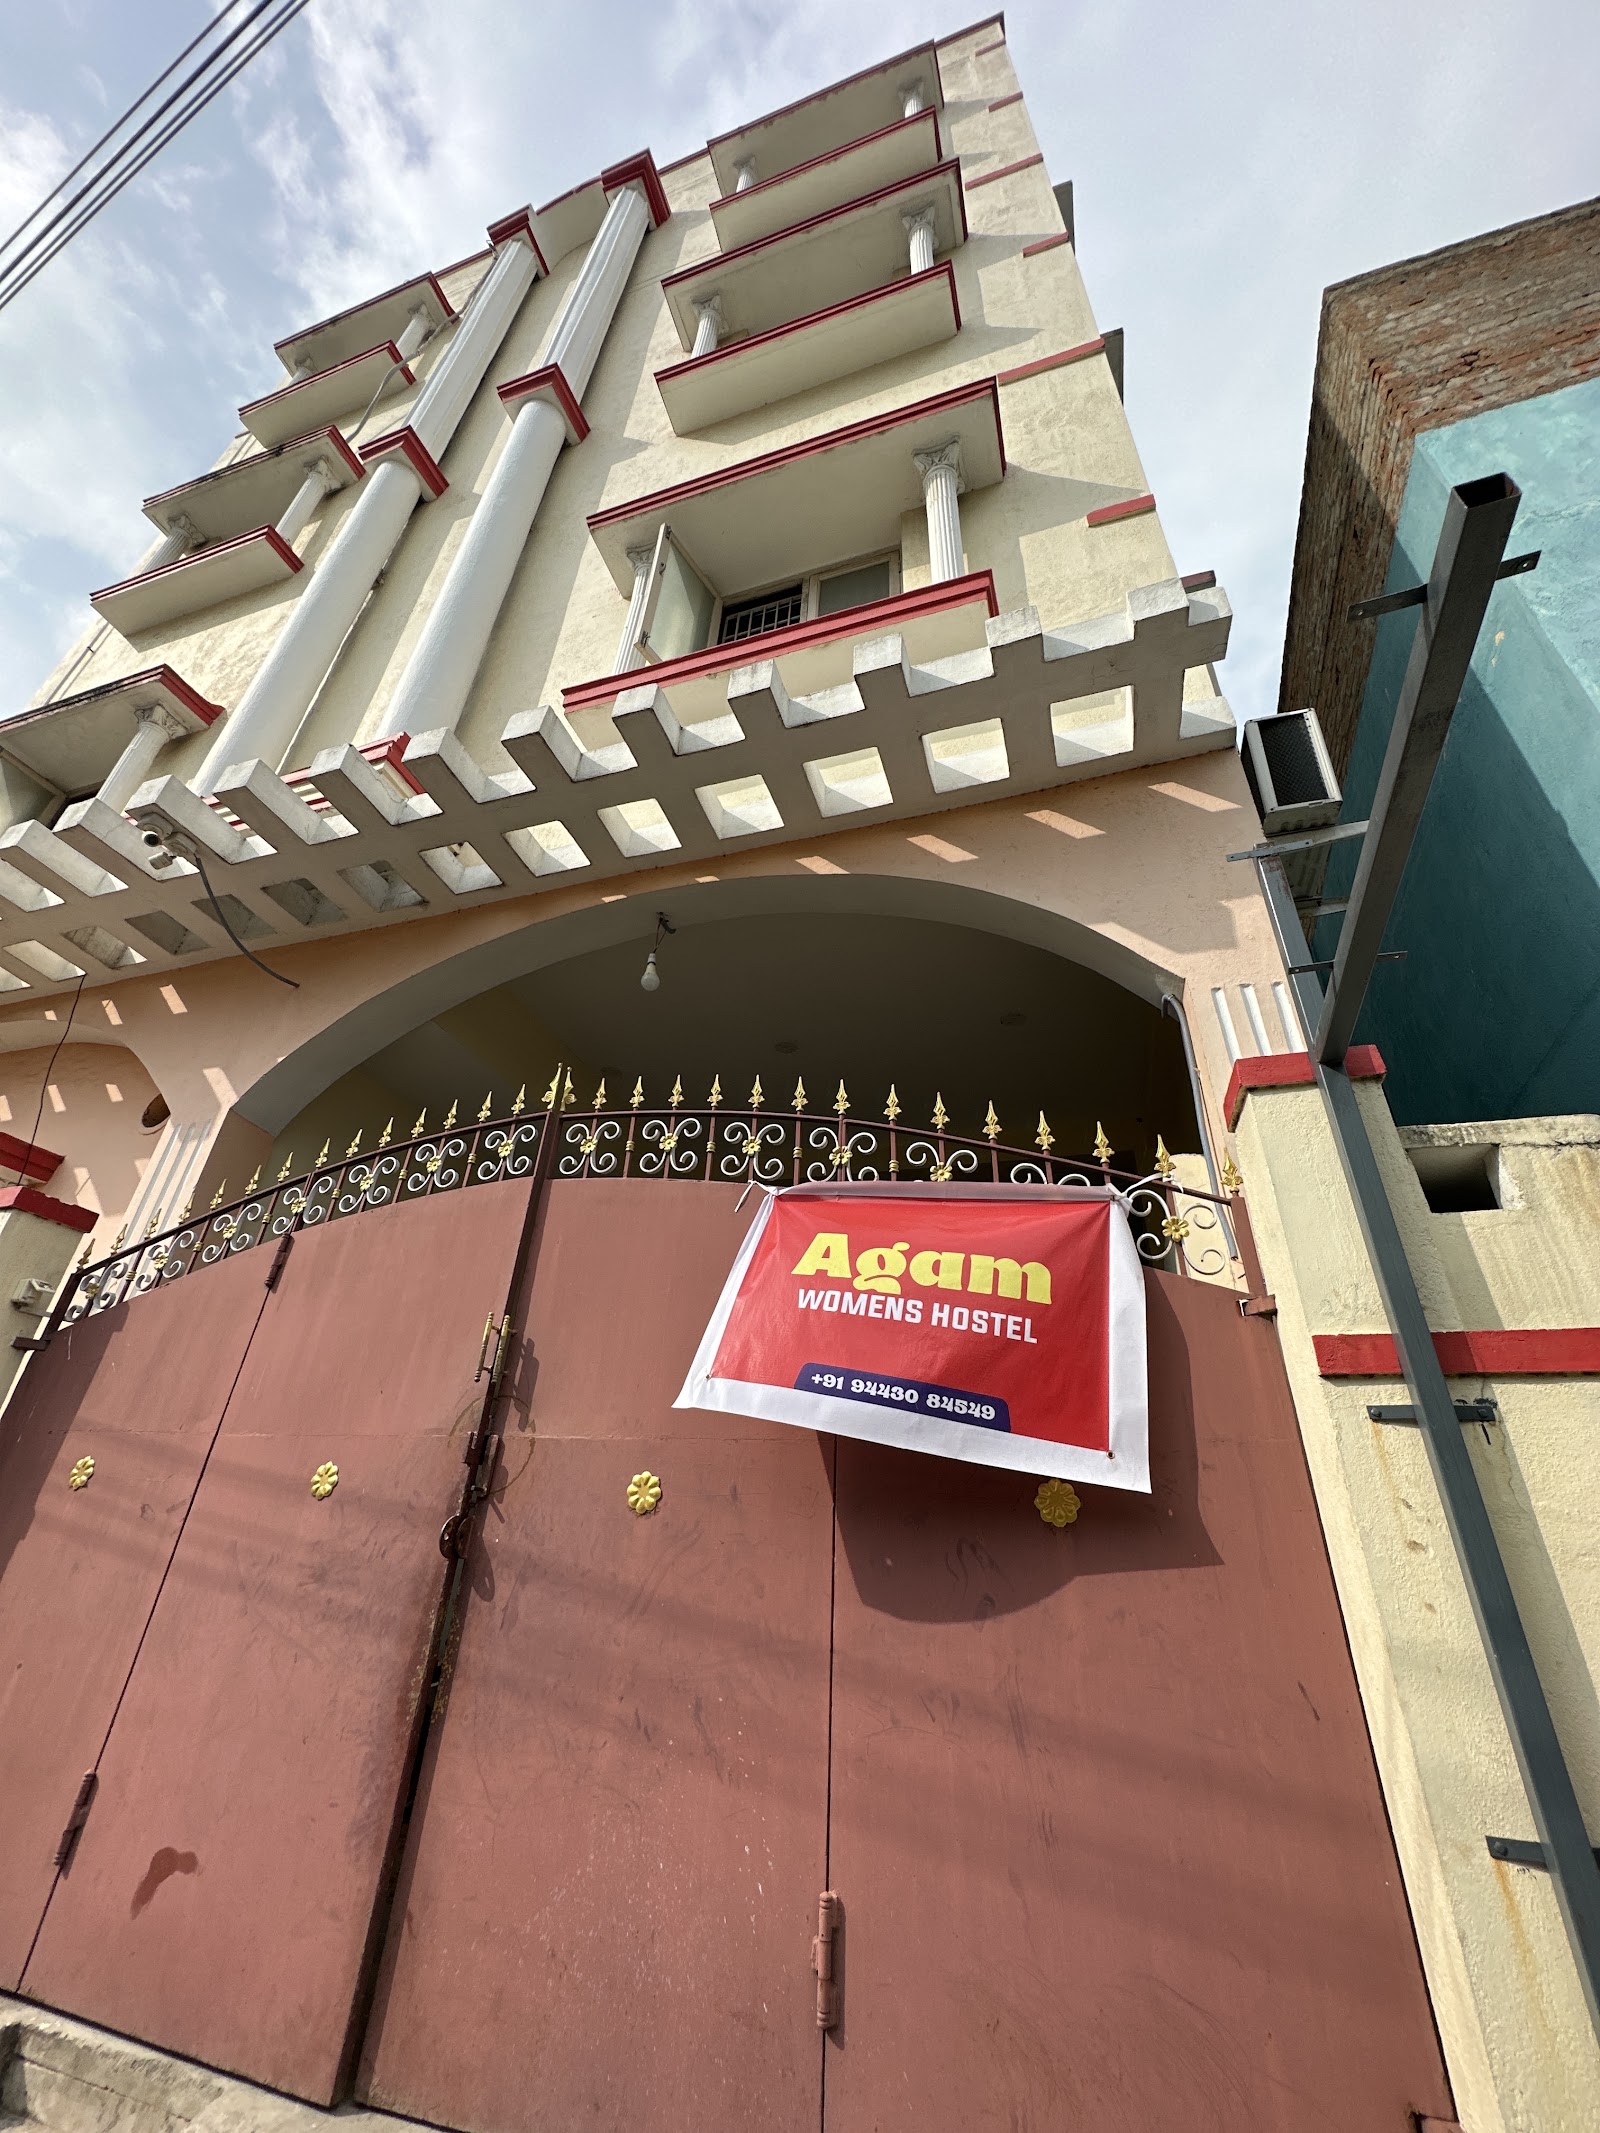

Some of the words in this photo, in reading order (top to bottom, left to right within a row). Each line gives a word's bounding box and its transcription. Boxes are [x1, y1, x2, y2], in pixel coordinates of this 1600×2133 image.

[791, 1233, 1052, 1305] Agam
[798, 1288, 922, 1324] WOMENS
[931, 1303, 1038, 1344] HOSTEL
[811, 1373, 844, 1391] +91
[850, 1379, 919, 1404] 94430
[926, 1392, 996, 1421] 84549
